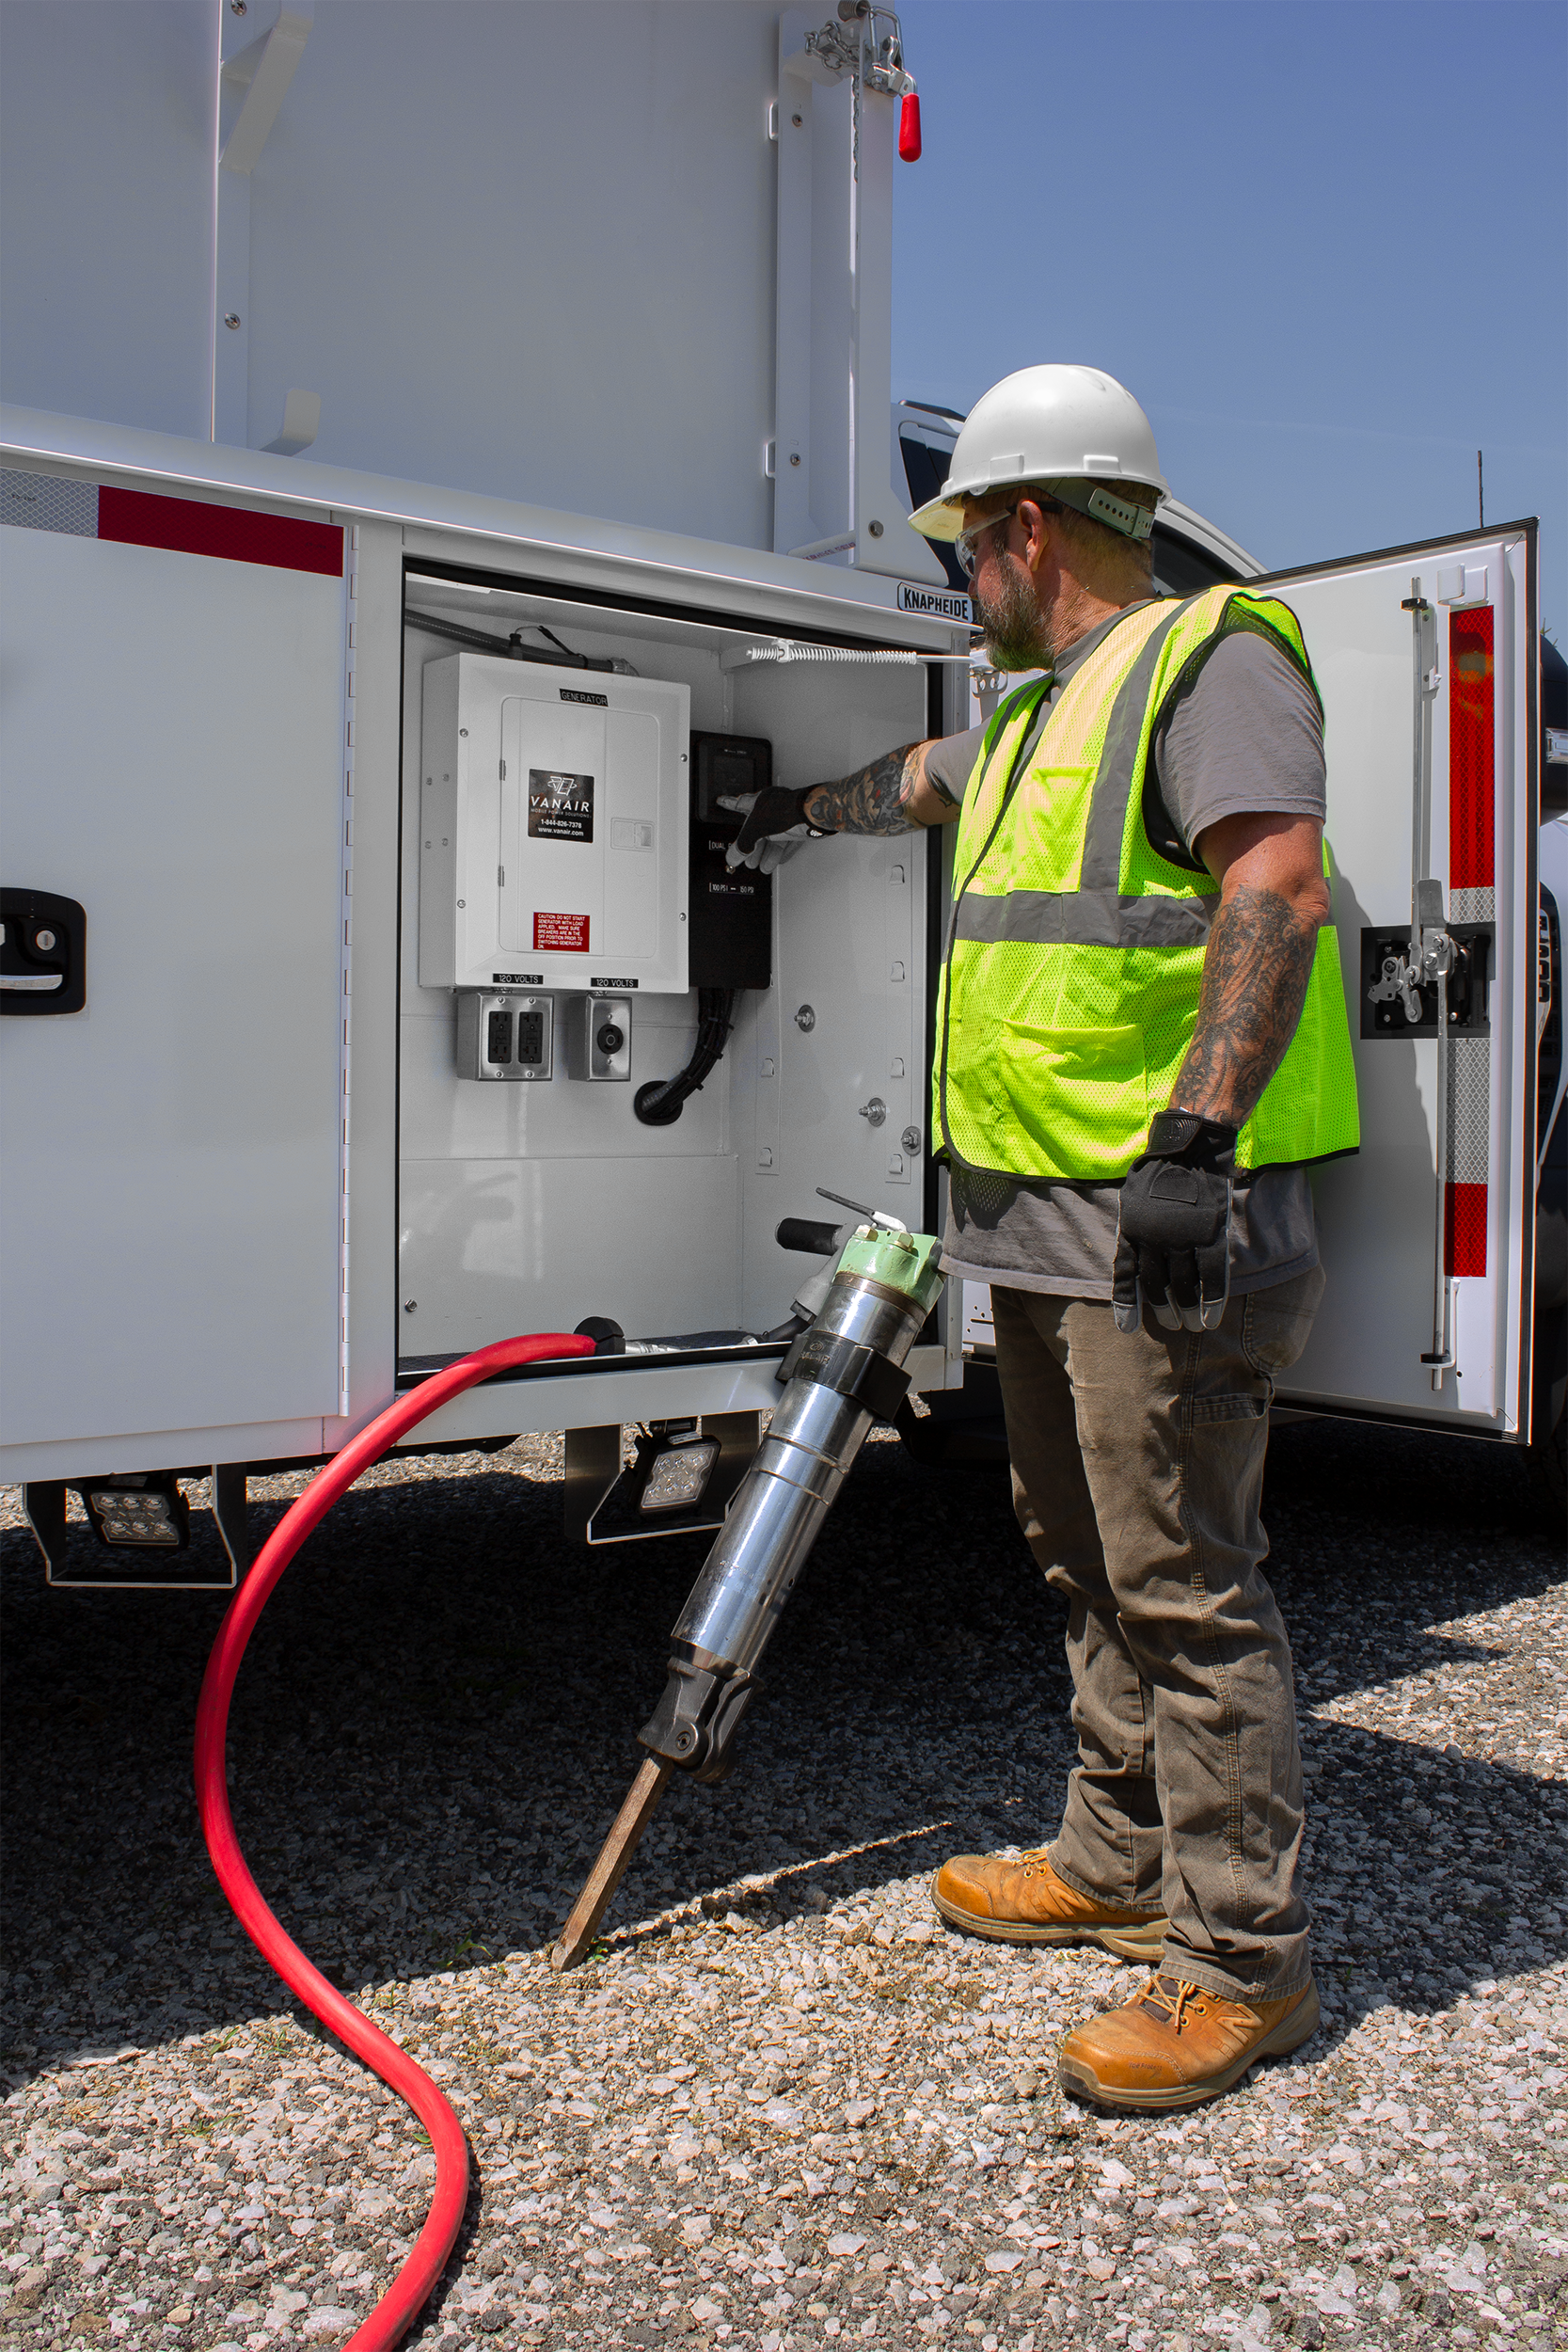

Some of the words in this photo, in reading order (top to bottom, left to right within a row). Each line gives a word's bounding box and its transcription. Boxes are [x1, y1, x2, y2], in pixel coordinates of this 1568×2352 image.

[904, 587, 969, 621] KNAPHEIDE
[562, 691, 608, 705] GENERATOR
[531, 796, 590, 812] VANAIR
[541, 818, 582, 829] 1-844-826-7378
[538, 827, 584, 836] www.vanair.com
[499, 975, 512, 983] 120
[515, 975, 538, 984] VOLTS
[596, 978, 609, 987] 120
[611, 979, 634, 988] VOLTS
